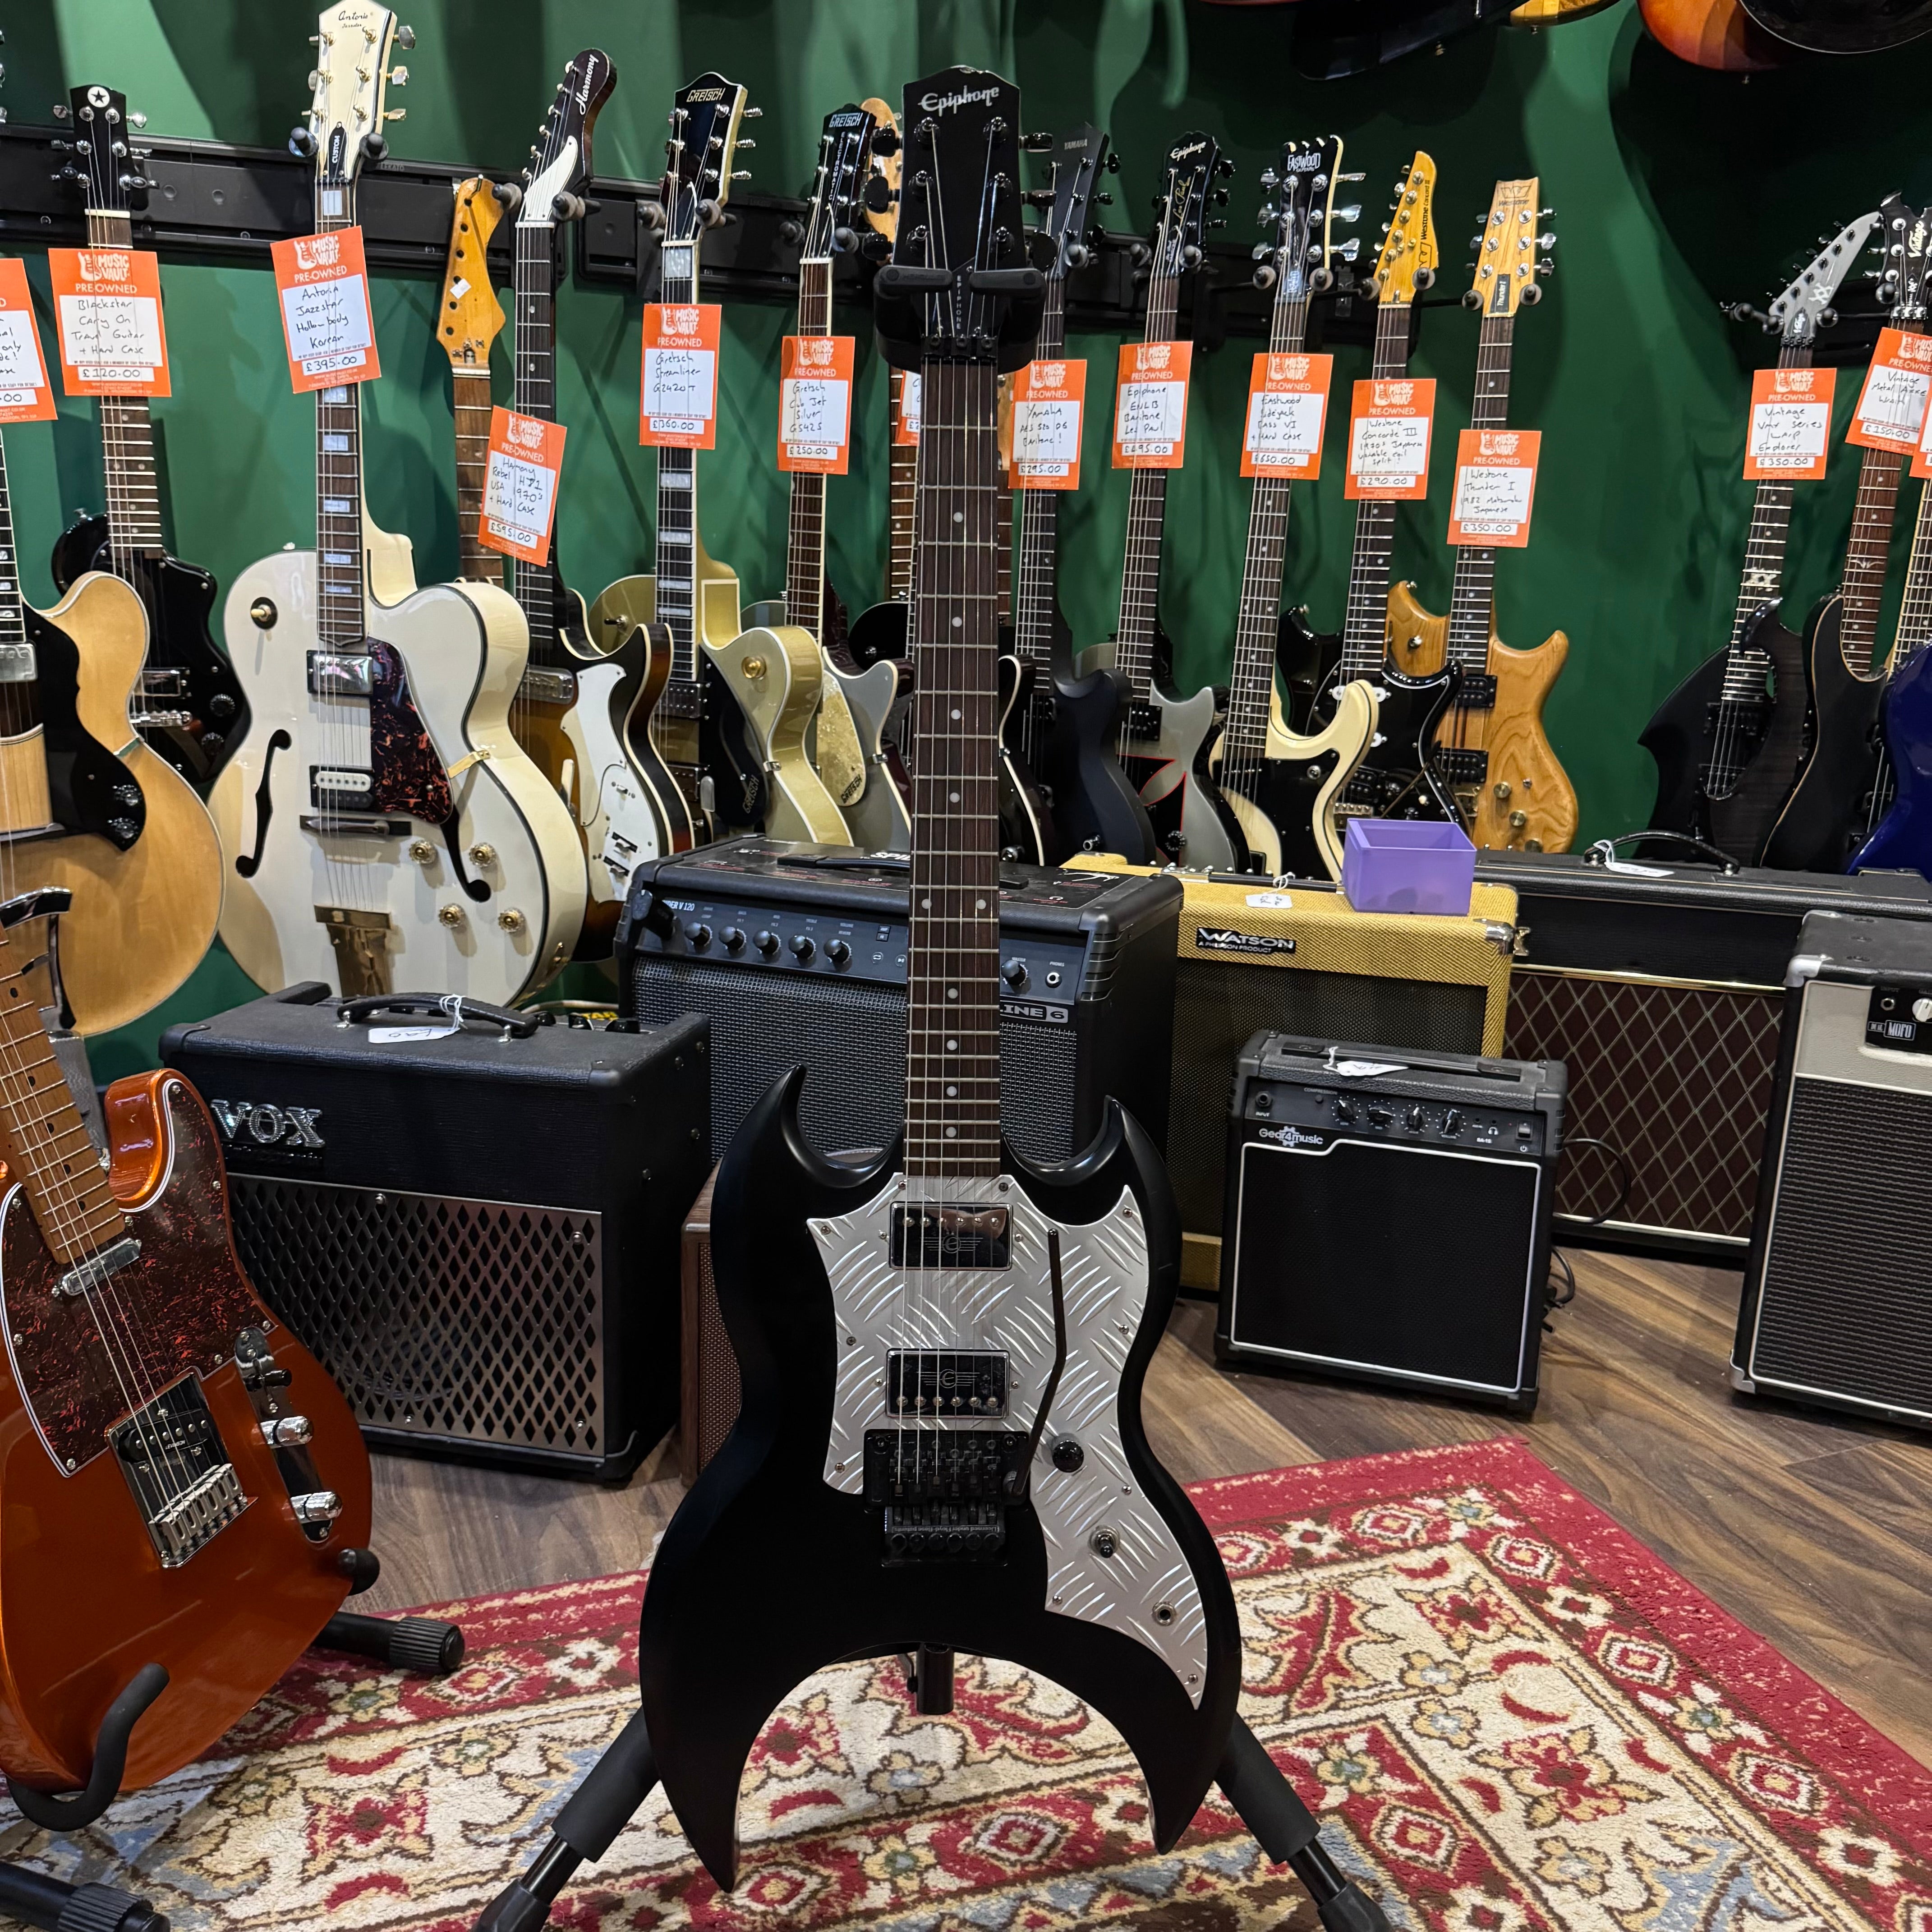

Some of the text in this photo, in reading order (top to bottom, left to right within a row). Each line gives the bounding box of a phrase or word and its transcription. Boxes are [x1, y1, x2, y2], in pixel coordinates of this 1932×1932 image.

[575, 54, 599, 115] Harmony
[686, 87, 726, 102] GRETSCH
[918, 85, 999, 117] Epiphone
[829, 112, 863, 128] GRETSCH
[331, 135, 340, 163] CUSTOM
[1064, 138, 1087, 150] YAMAHA
[1170, 142, 1206, 161] Epiphone
[828, 131, 846, 200] ELECTROMATIC
[313, 235, 340, 249] MUSIC
[1907, 221, 1927, 258] Vintage
[98, 253, 129, 267] MUSIC
[116, 315, 130, 324] On
[676, 307, 699, 322] MUSIC
[812, 339, 834, 353] MUSIC
[1148, 345, 1171, 358] MUSIC
[1914, 340, 1932, 350] MUS
[307, 357, 357, 372] £395.00
[1043, 363, 1066, 376] MUSIC
[1285, 356, 1310, 369] MUSIC
[1889, 358, 1932, 373] PRE-OWNE
[83, 368, 140, 377] £120.00
[1789, 371, 1814, 382] MUSIC
[1389, 382, 1414, 395] MUSIC
[520, 420, 544, 436] MUSIC
[653, 419, 695, 430] £360.00
[1494, 433, 1520, 446] MUSIC
[790, 446, 828, 455] £250.00
[1760, 458, 1808, 466] £350.00
[1021, 465, 1061, 474] £295.00
[491, 481, 505, 490] USA
[1361, 477, 1407, 485] £290.00
[490, 522, 531, 542] £595.00
[1463, 524, 1511, 532] £350.00
[684, 902, 695, 911] 120
[1199, 928, 1293, 948] WATSON
[1000, 1004, 1064, 1019] INE 6
[1887, 1022, 1912, 1038] MOFO
[211, 1099, 326, 1148] VOX
[1259, 1127, 1323, 1147] Gear4music
